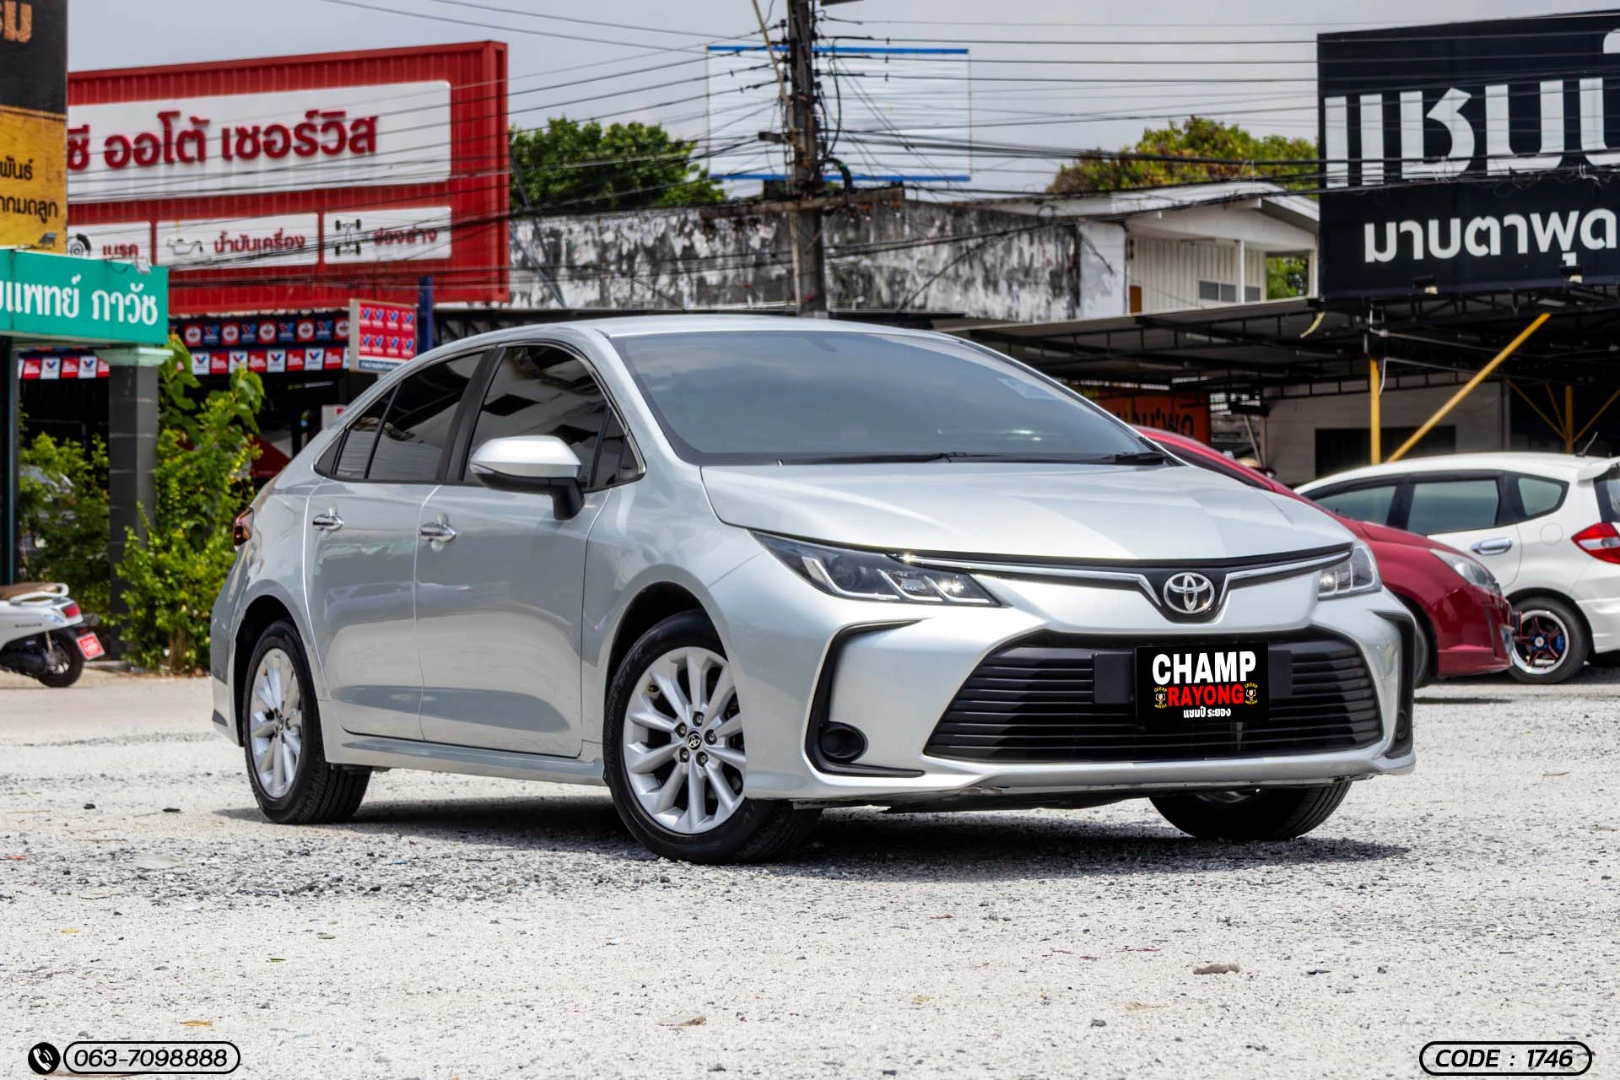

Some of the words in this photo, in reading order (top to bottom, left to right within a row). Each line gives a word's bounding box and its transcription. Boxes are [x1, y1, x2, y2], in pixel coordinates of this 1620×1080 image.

[0, 1, 33, 43] ม
[103, 110, 211, 170] ออโต้
[221, 109, 378, 162] เซอร์วิส
[213, 228, 306, 254] น้ำมันเครื่อง
[1363, 208, 1617, 266] มาบตาพุด
[0, 273, 82, 318] แพทย์
